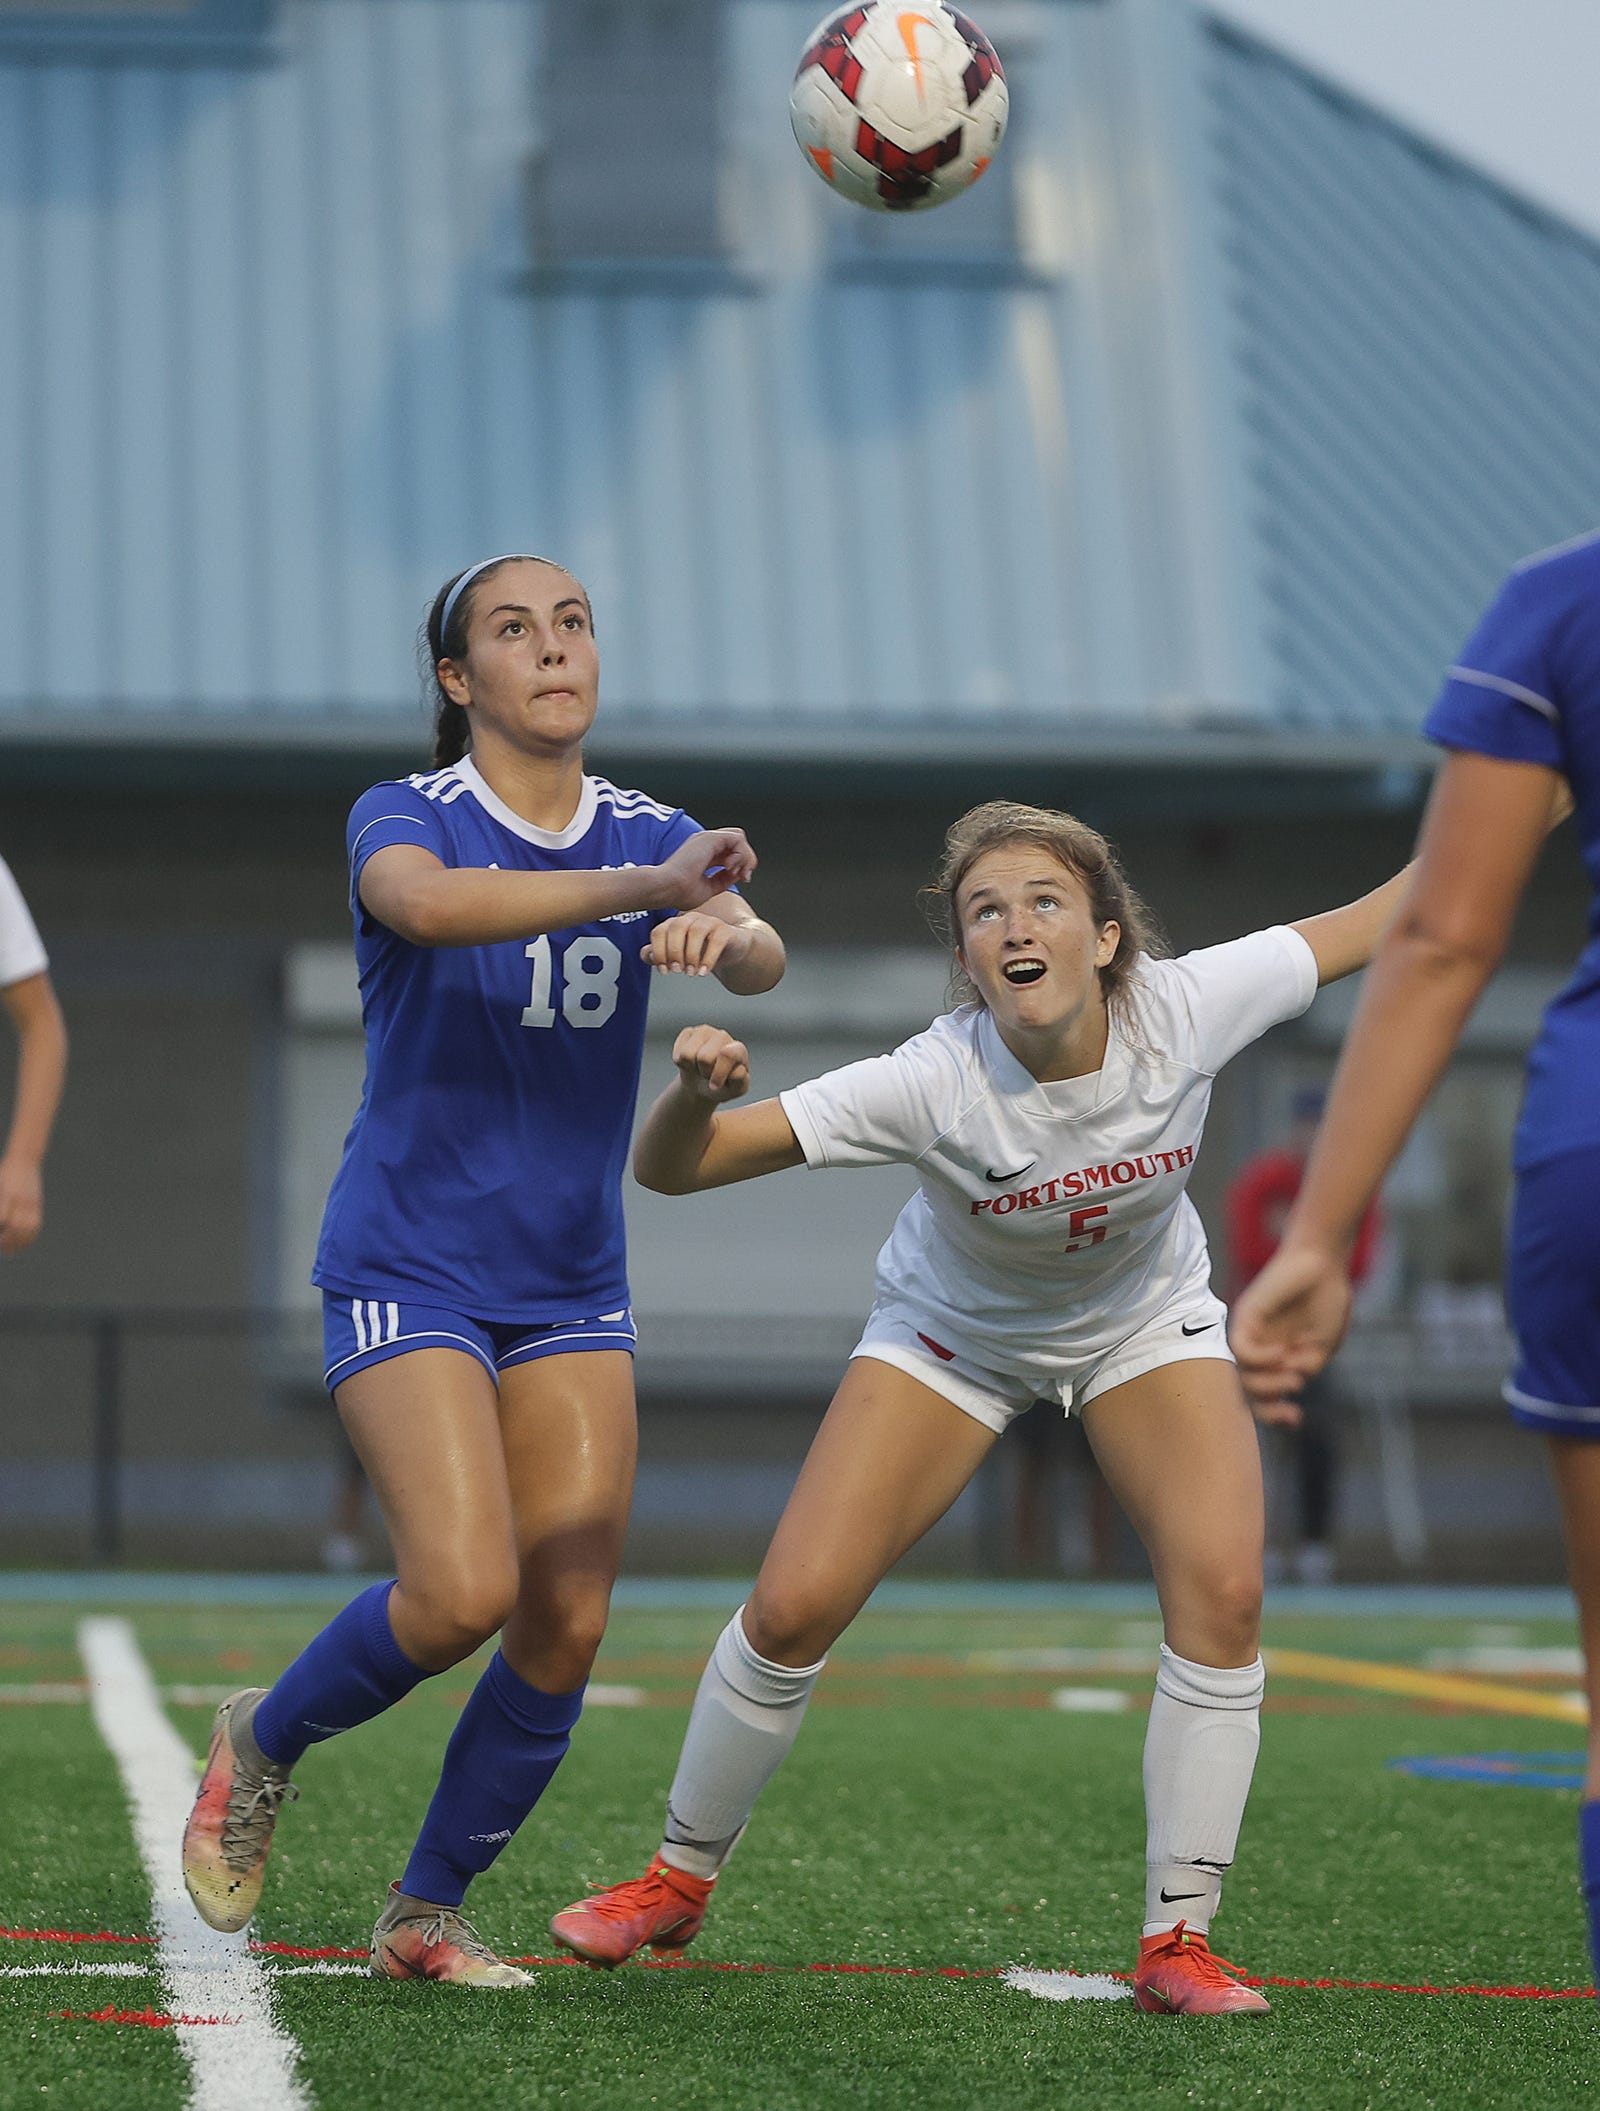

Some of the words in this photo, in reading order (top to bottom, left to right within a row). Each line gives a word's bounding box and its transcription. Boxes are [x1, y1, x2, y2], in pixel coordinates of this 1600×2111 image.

[520, 934, 622, 1028] 18
[970, 1145, 1194, 1215] PORTSMOUTH
[1065, 1205, 1109, 1253] 5
